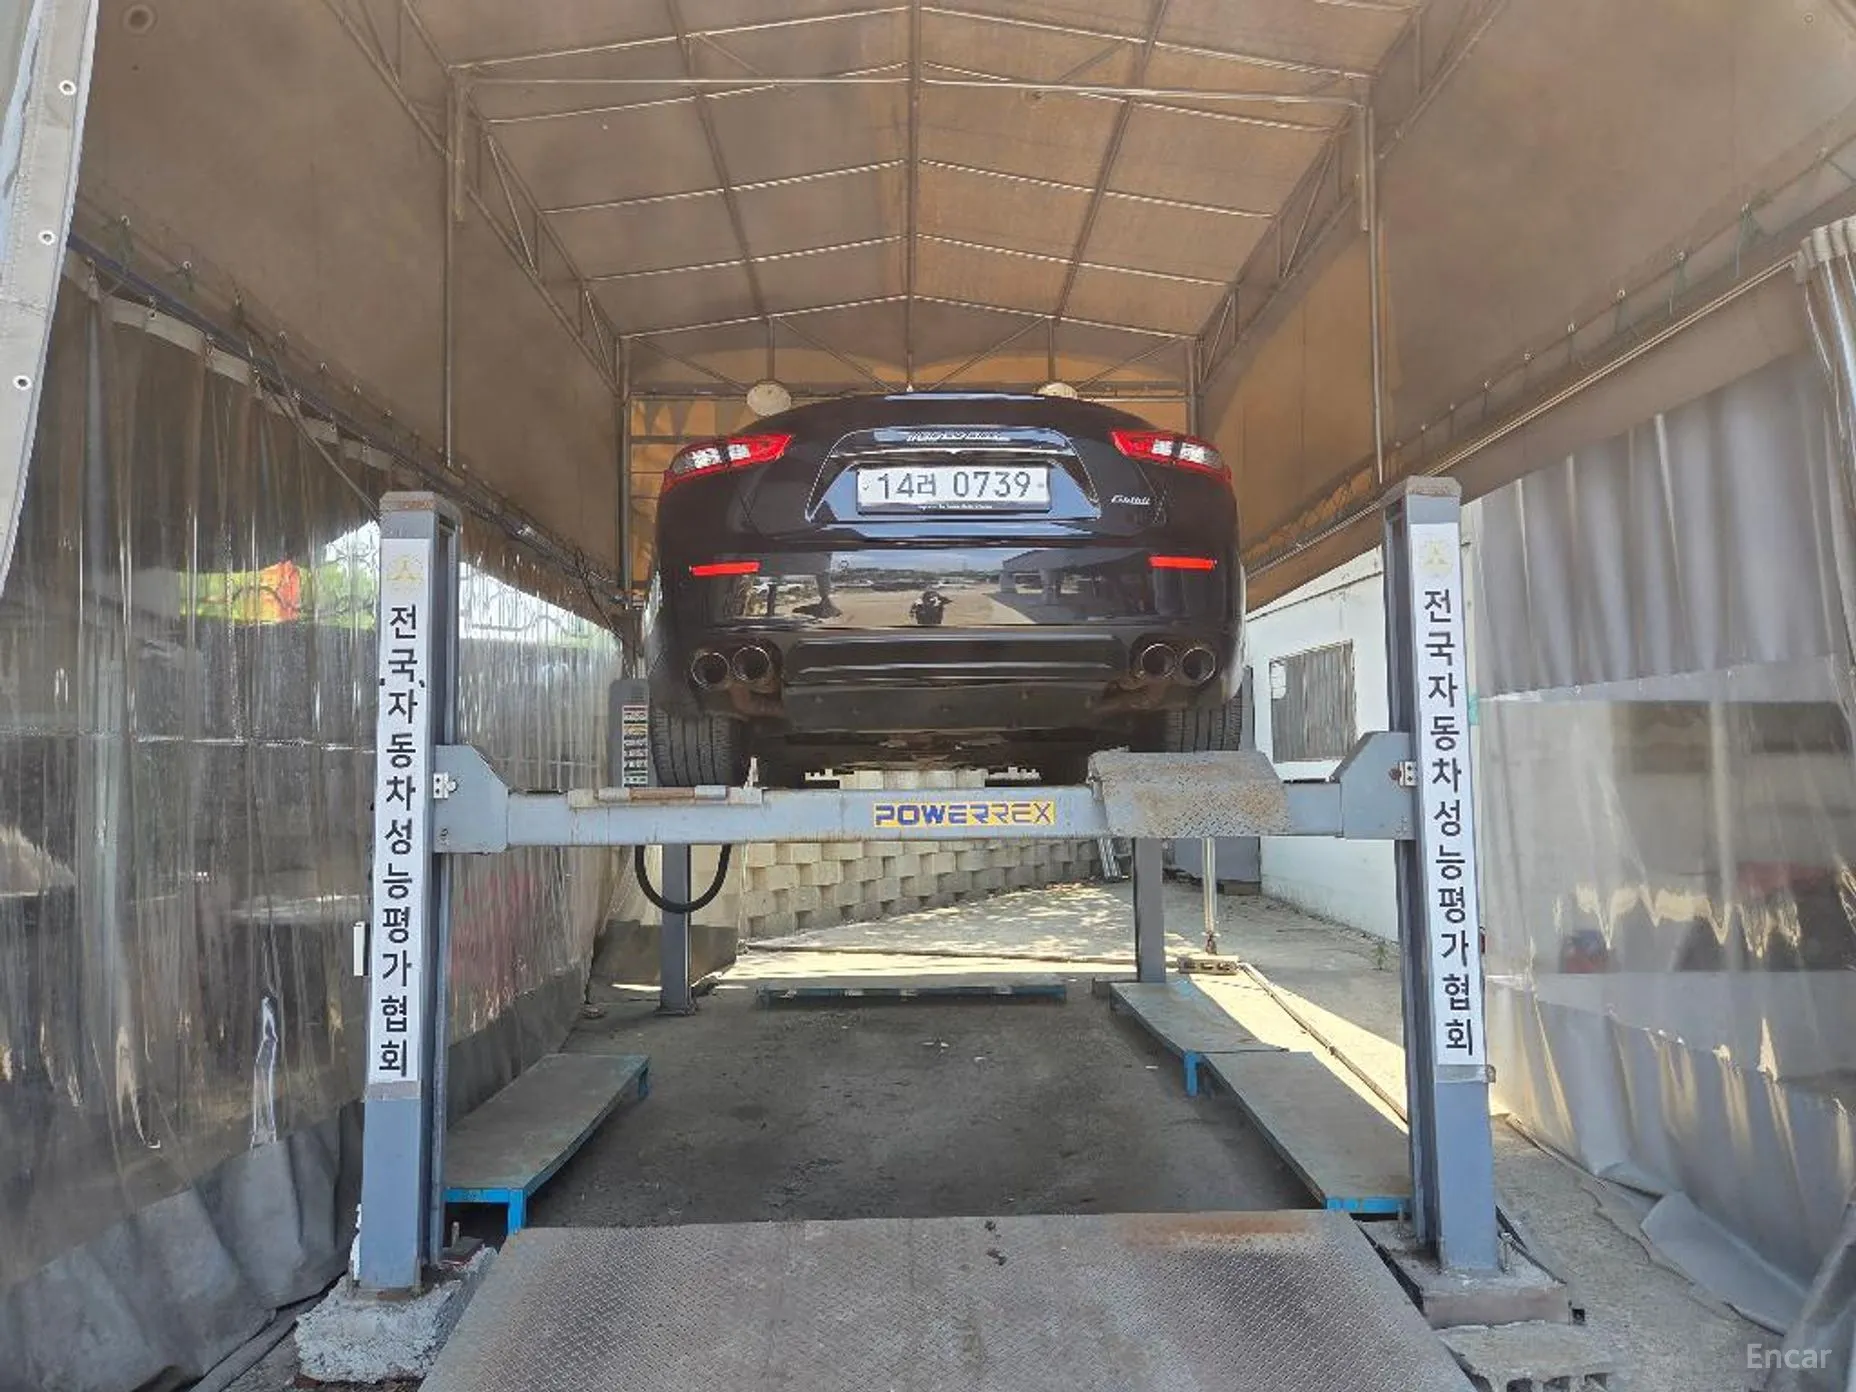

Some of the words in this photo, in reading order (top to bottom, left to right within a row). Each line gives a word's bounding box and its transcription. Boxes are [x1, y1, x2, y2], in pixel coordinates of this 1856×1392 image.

[877, 472, 937, 500] 14러
[953, 471, 1031, 498] 0739
[378, 604, 419, 1079] 전국자동차성능평가협회
[875, 803, 1051, 826] POWERREX
[1424, 588, 1474, 1056] 전국자동차성능평가협회
